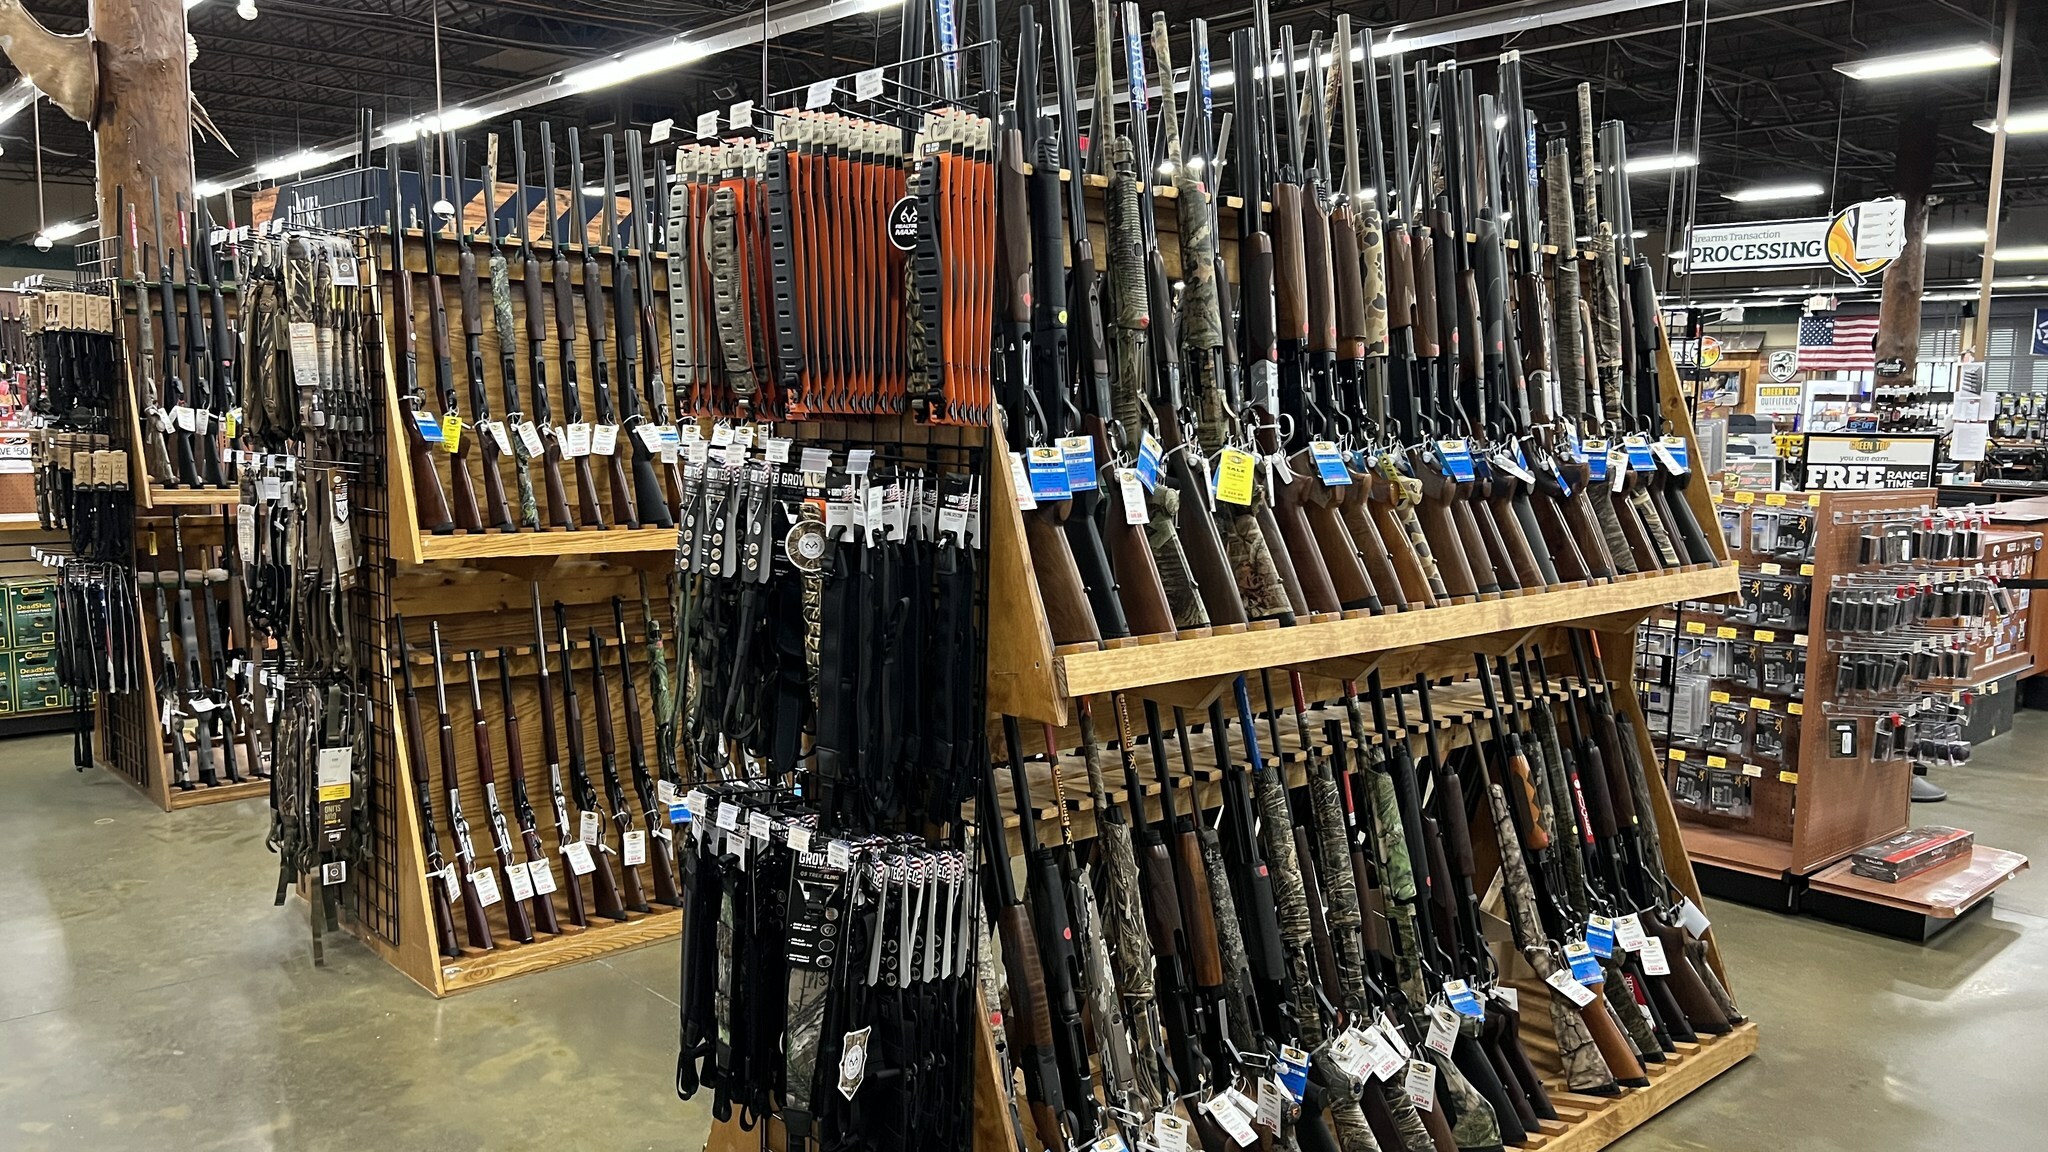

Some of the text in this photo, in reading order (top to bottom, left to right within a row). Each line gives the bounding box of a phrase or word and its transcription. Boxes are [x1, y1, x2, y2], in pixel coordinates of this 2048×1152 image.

[1729, 230, 1781, 242] Transaction
[1691, 240, 1822, 264] PROCESSING
[1761, 387, 1799, 396] GREEN TOP
[1760, 397, 1798, 406] OUTFITTERS
[1805, 465, 1928, 489] FREE RANGE
[1886, 479, 1914, 489] TIME
[1577, 790, 1593, 836] RUGER
